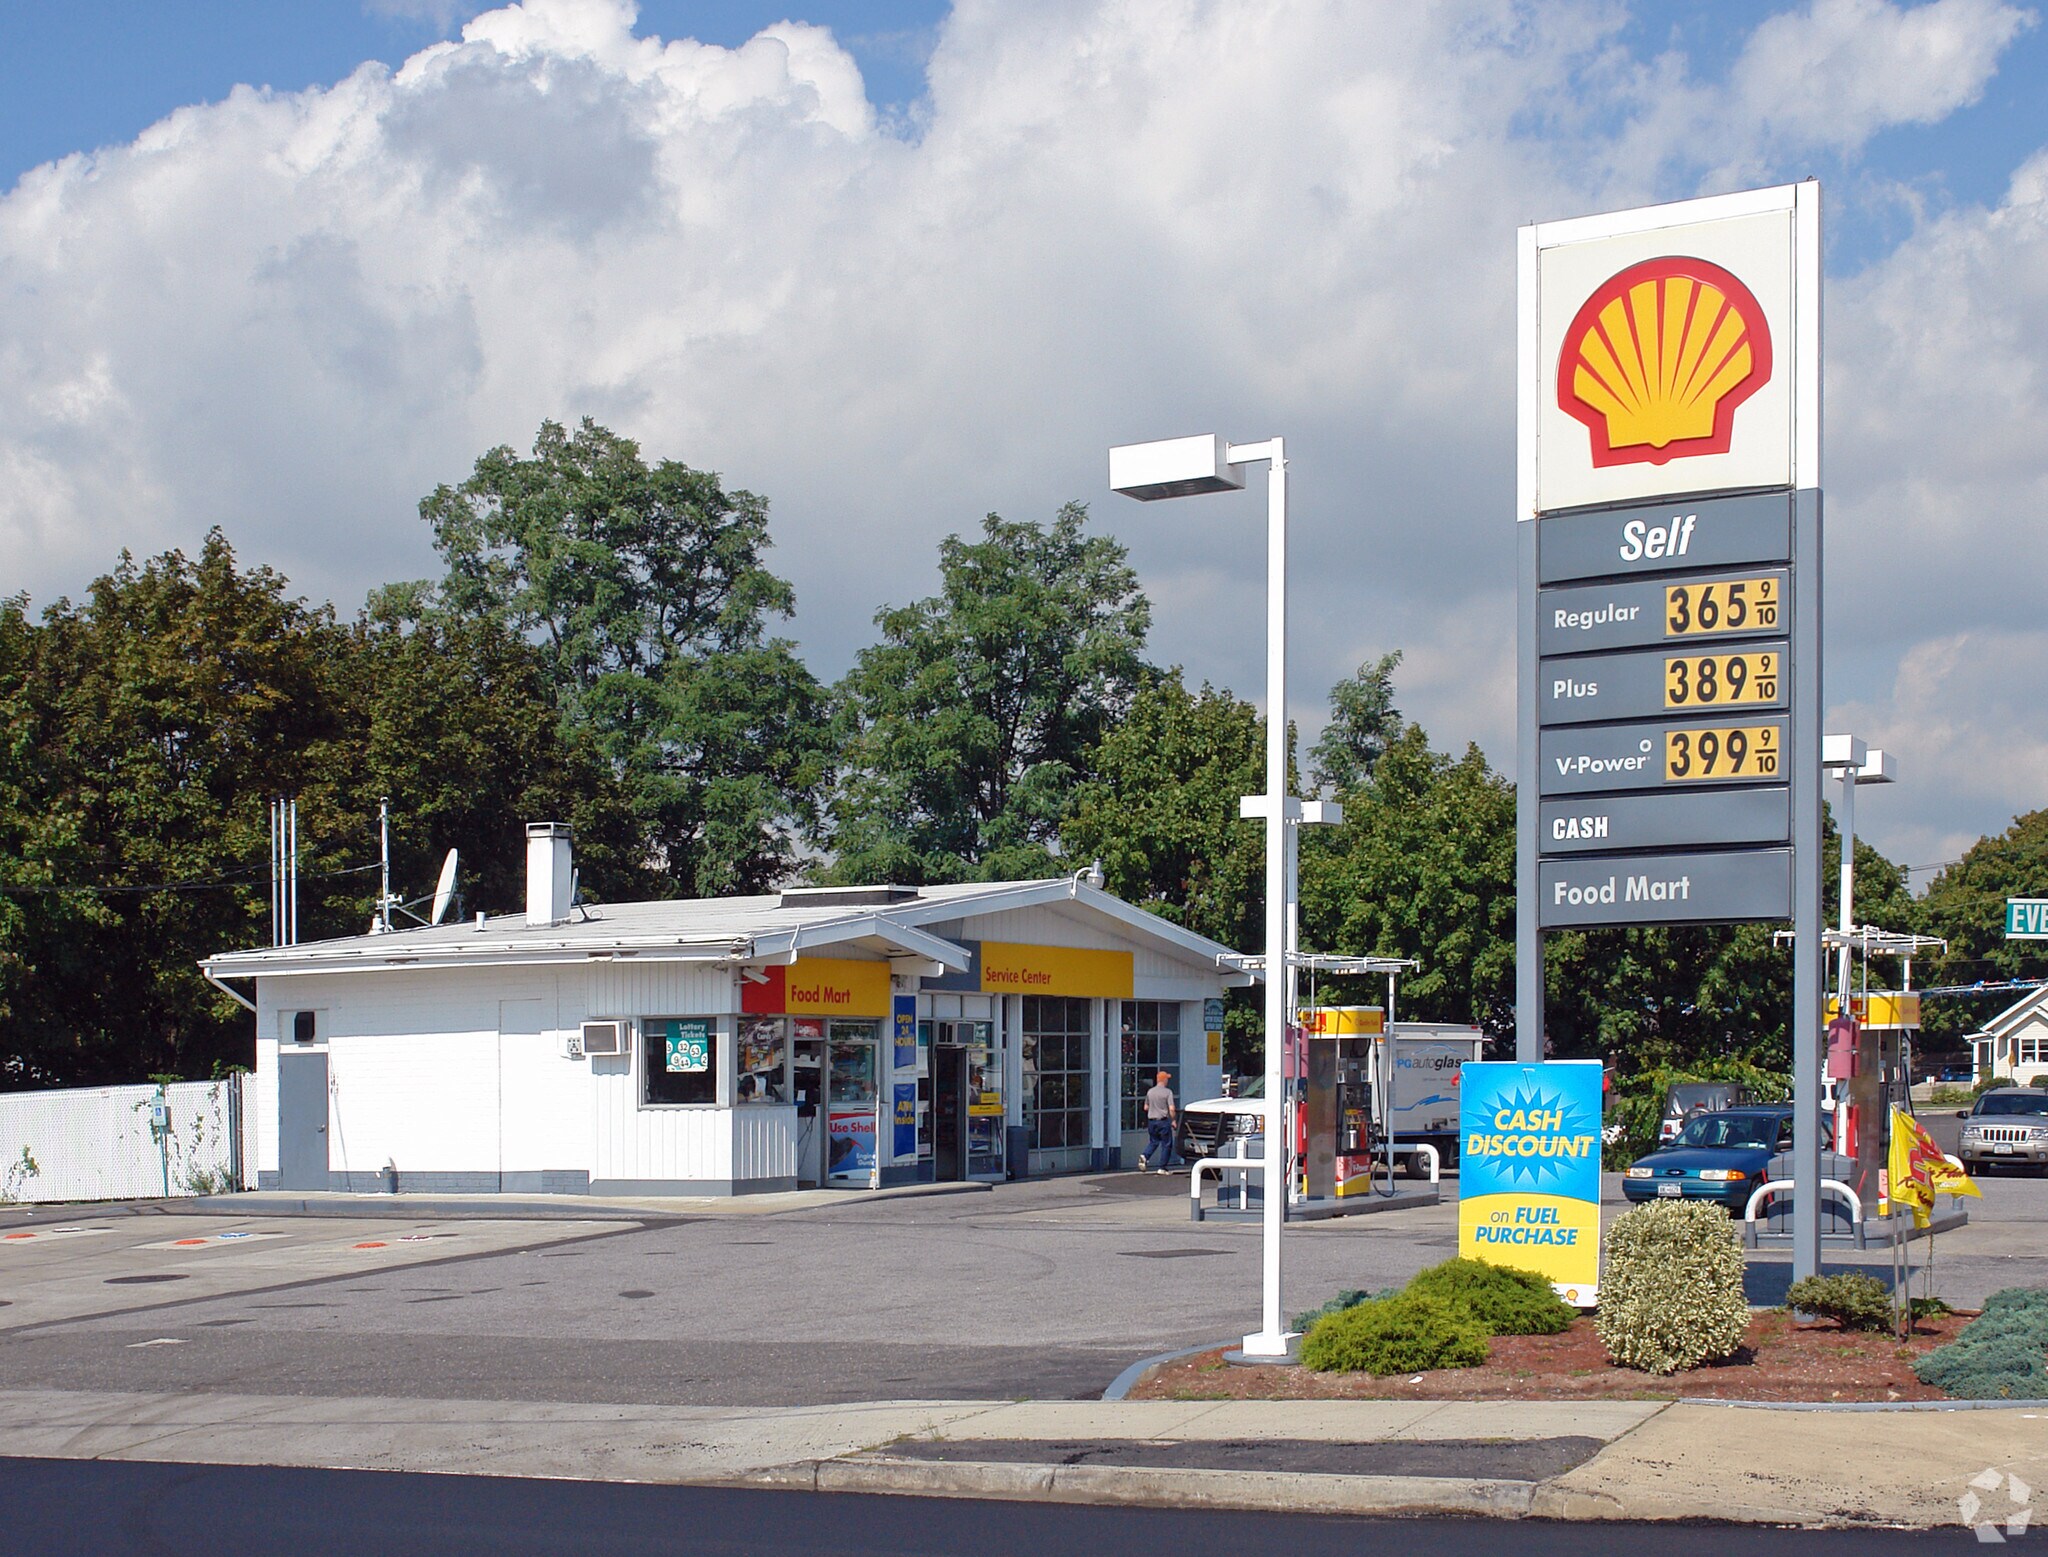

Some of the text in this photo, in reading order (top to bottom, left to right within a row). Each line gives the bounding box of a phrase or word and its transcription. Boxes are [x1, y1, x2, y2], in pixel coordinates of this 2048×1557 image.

[1619, 513, 1698, 563] Self
[1554, 603, 1640, 631] Regular
[1668, 581, 1776, 634] 365 9 10
[1553, 679, 1598, 699] Plus
[1668, 655, 1776, 704] 389 9 10
[1670, 729, 1776, 778] 399 9 10
[1555, 754, 1648, 776] V-Power
[1552, 816, 1608, 840] CASH
[1554, 875, 1690, 906] Food Mart
[2012, 904, 2048, 932] EVE
[985, 966, 1052, 986] Service Center
[791, 985, 851, 1003] Food Mart
[679, 1023, 705, 1031] Lottery
[897, 1014, 912, 1024] OPEN
[901, 1025, 910, 1036] 24
[830, 1121, 876, 1133] Use Shell
[1493, 1108, 1562, 1131] CASH
[1467, 1135, 1595, 1158] DISCOUNT
[1490, 1207, 1560, 1225] on FUEL
[1475, 1227, 1579, 1246] PURCHASE
